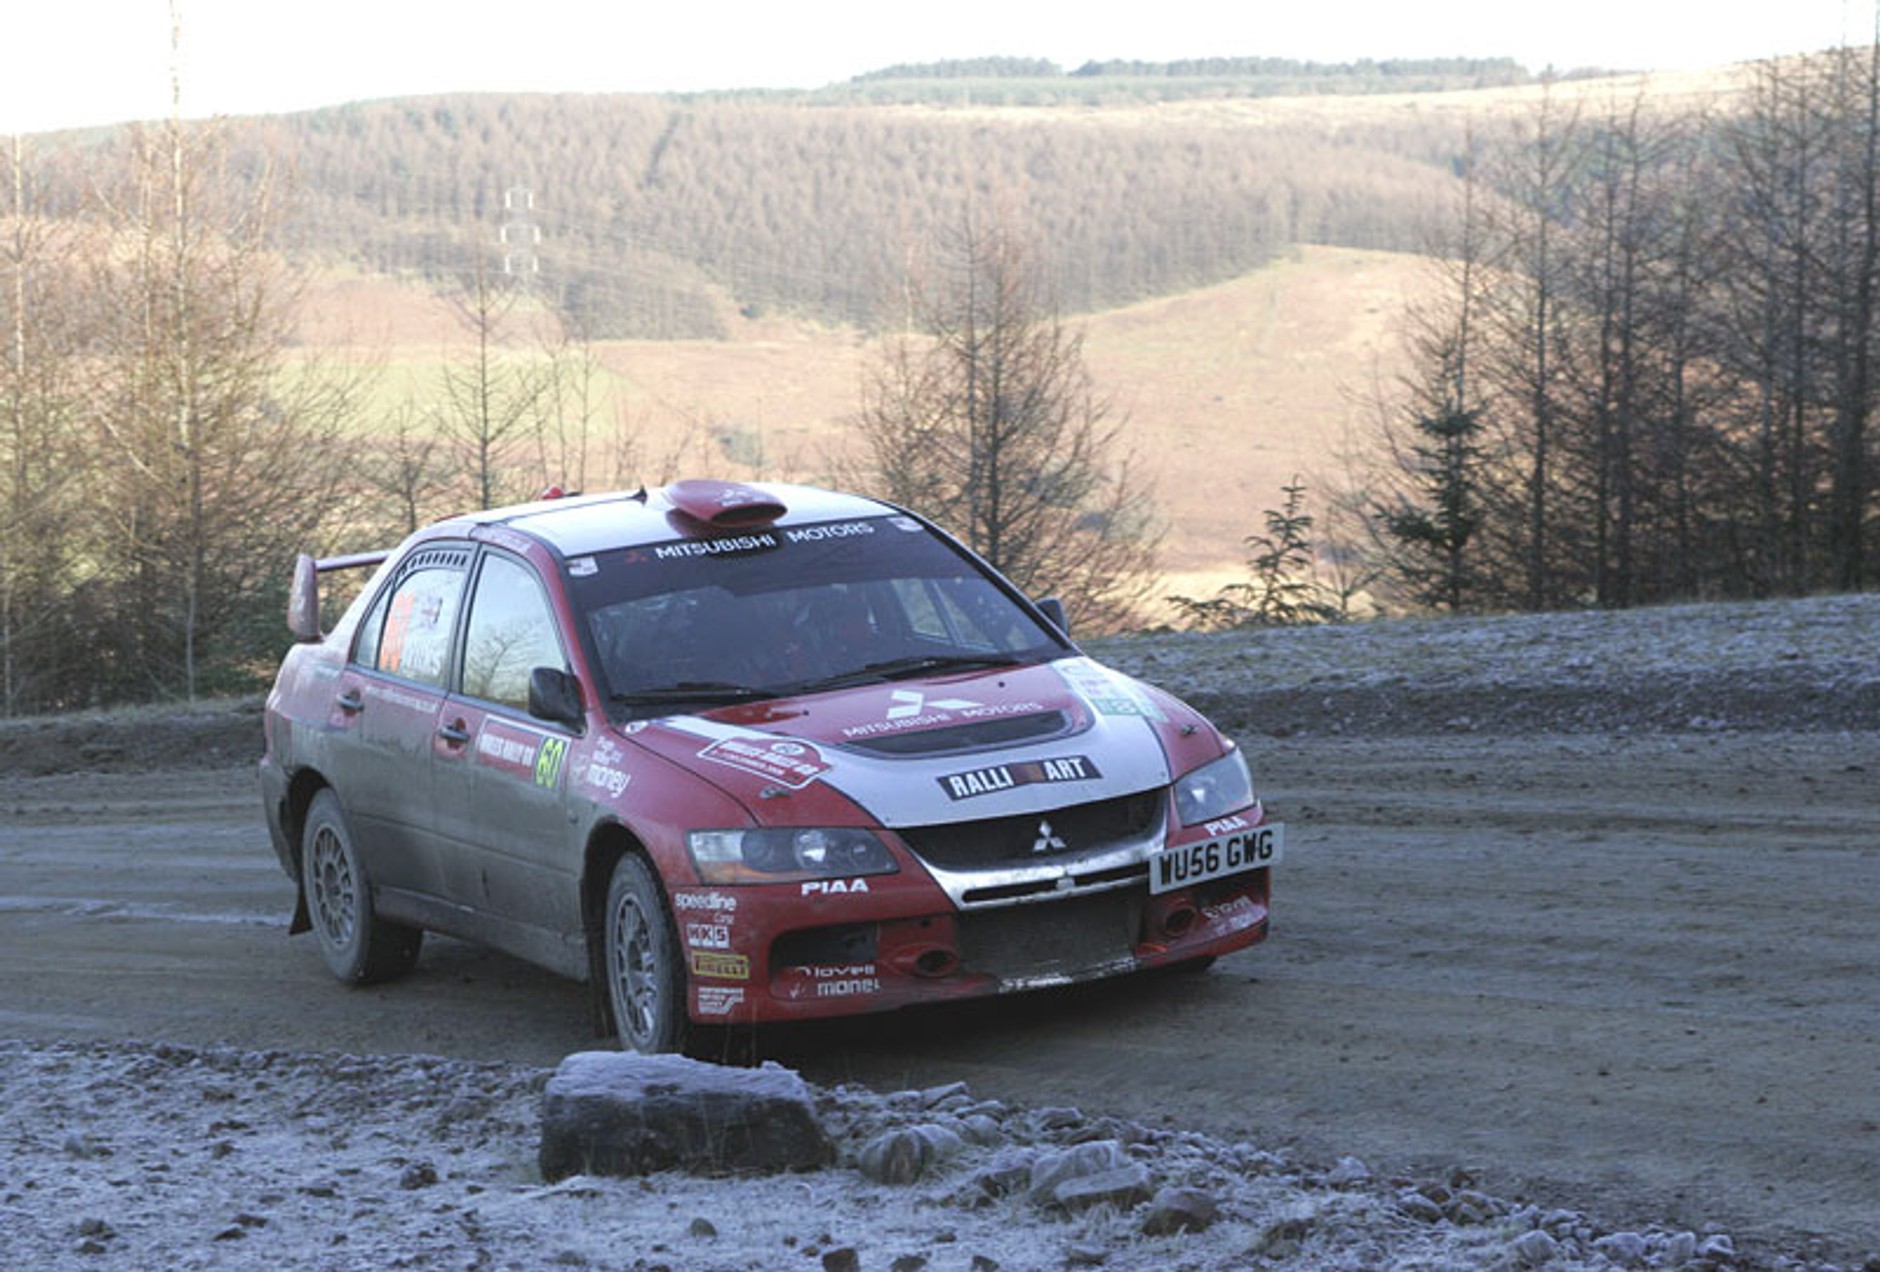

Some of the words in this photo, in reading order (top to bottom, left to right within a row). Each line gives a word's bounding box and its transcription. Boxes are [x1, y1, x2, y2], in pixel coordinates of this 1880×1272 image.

[655, 533, 776, 559] MITSUBISHI
[786, 521, 875, 543] MOTORS
[842, 713, 952, 738] MITSUBISHI
[961, 702, 1044, 718] MOTORS
[535, 737, 565, 790] 60
[586, 764, 632, 798] money
[949, 765, 1015, 798] RALLI
[1042, 758, 1087, 781] ART
[1203, 815, 1249, 837] PIAA
[1158, 842, 1220, 886] WU56
[1226, 830, 1274, 868] GWG
[674, 891, 738, 912] speedline
[801, 878, 869, 896] PIAA
